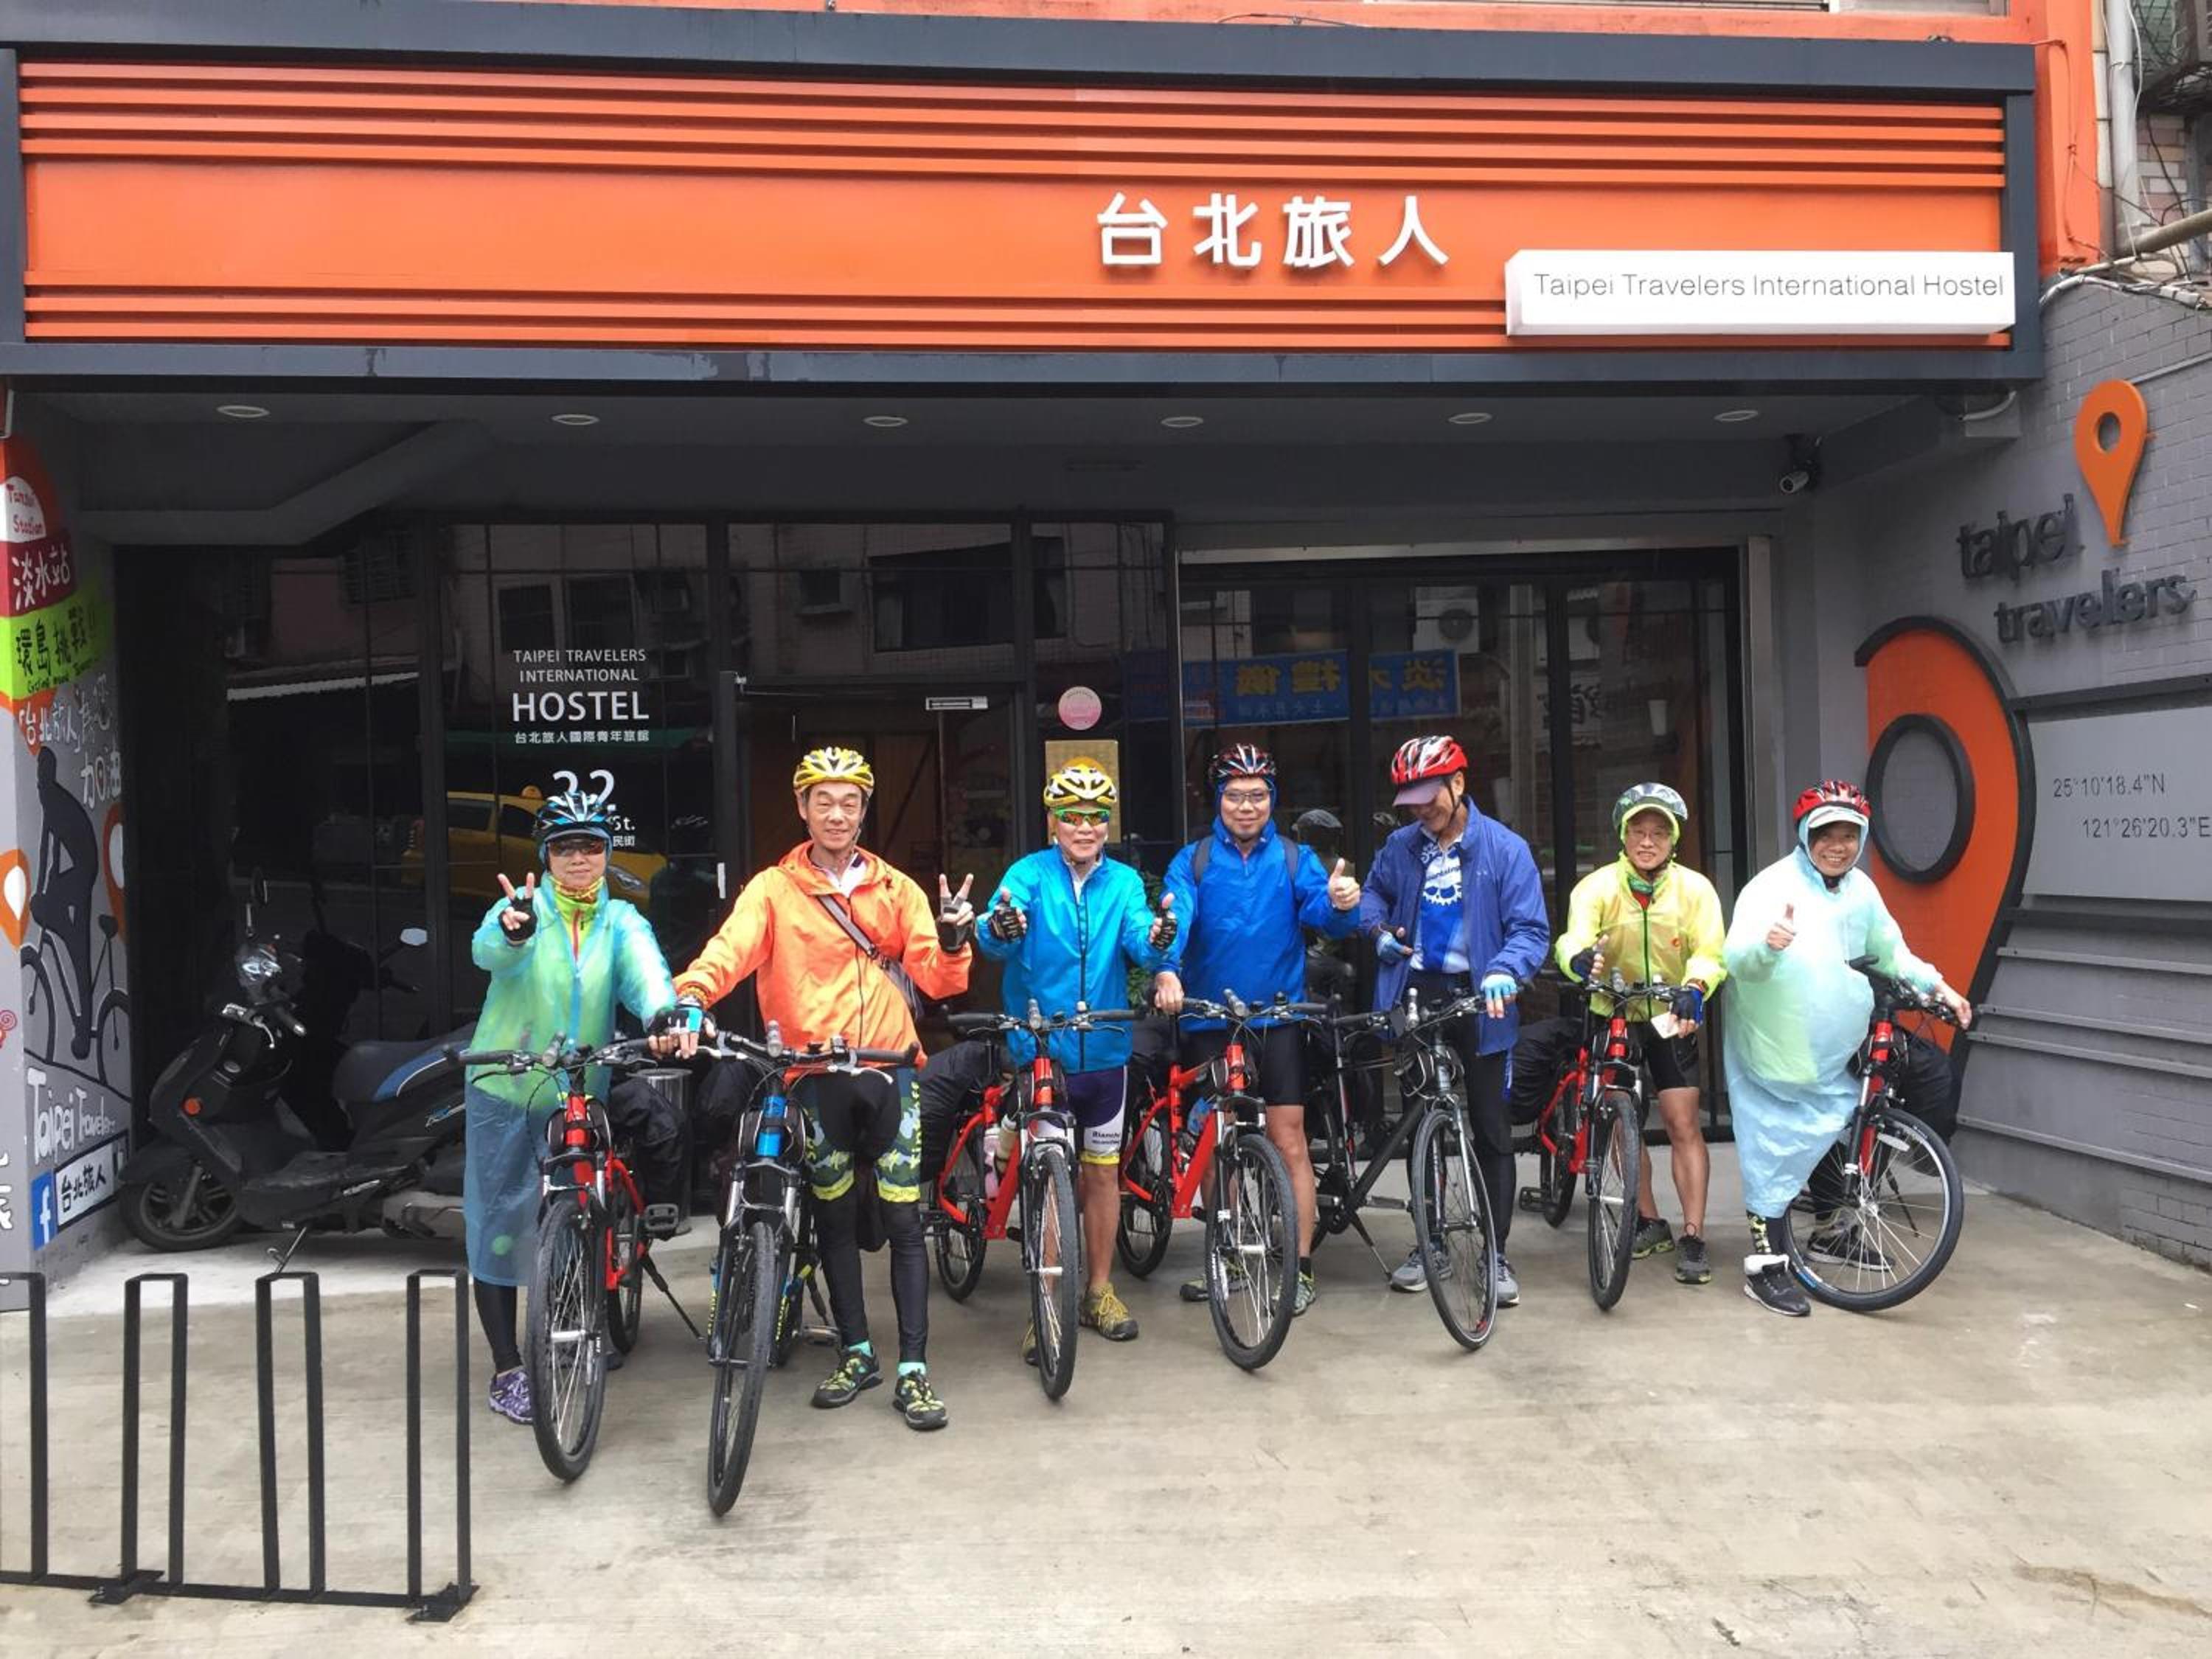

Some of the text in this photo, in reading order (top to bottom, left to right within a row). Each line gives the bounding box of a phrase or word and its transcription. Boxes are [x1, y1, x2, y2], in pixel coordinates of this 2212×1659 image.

[1096, 192, 1450, 268] 台北旅人
[1534, 274, 2003, 299] Taipei Travelers International Hostel
[1955, 493, 2084, 583] taipei
[11, 543, 71, 611] 淡水站
[1993, 568, 2197, 643] travelers
[512, 649, 647, 663] TAIPEI TRAVELERS
[520, 668, 639, 683] INTERNATIONAL
[512, 691, 650, 722] HOSTEL
[515, 730, 650, 744] 台北旅人國際青年旅館
[80, 738, 122, 809] 加油
[27, 1067, 74, 1165] Taipei
[61, 1164, 106, 1213] 台北旅人
